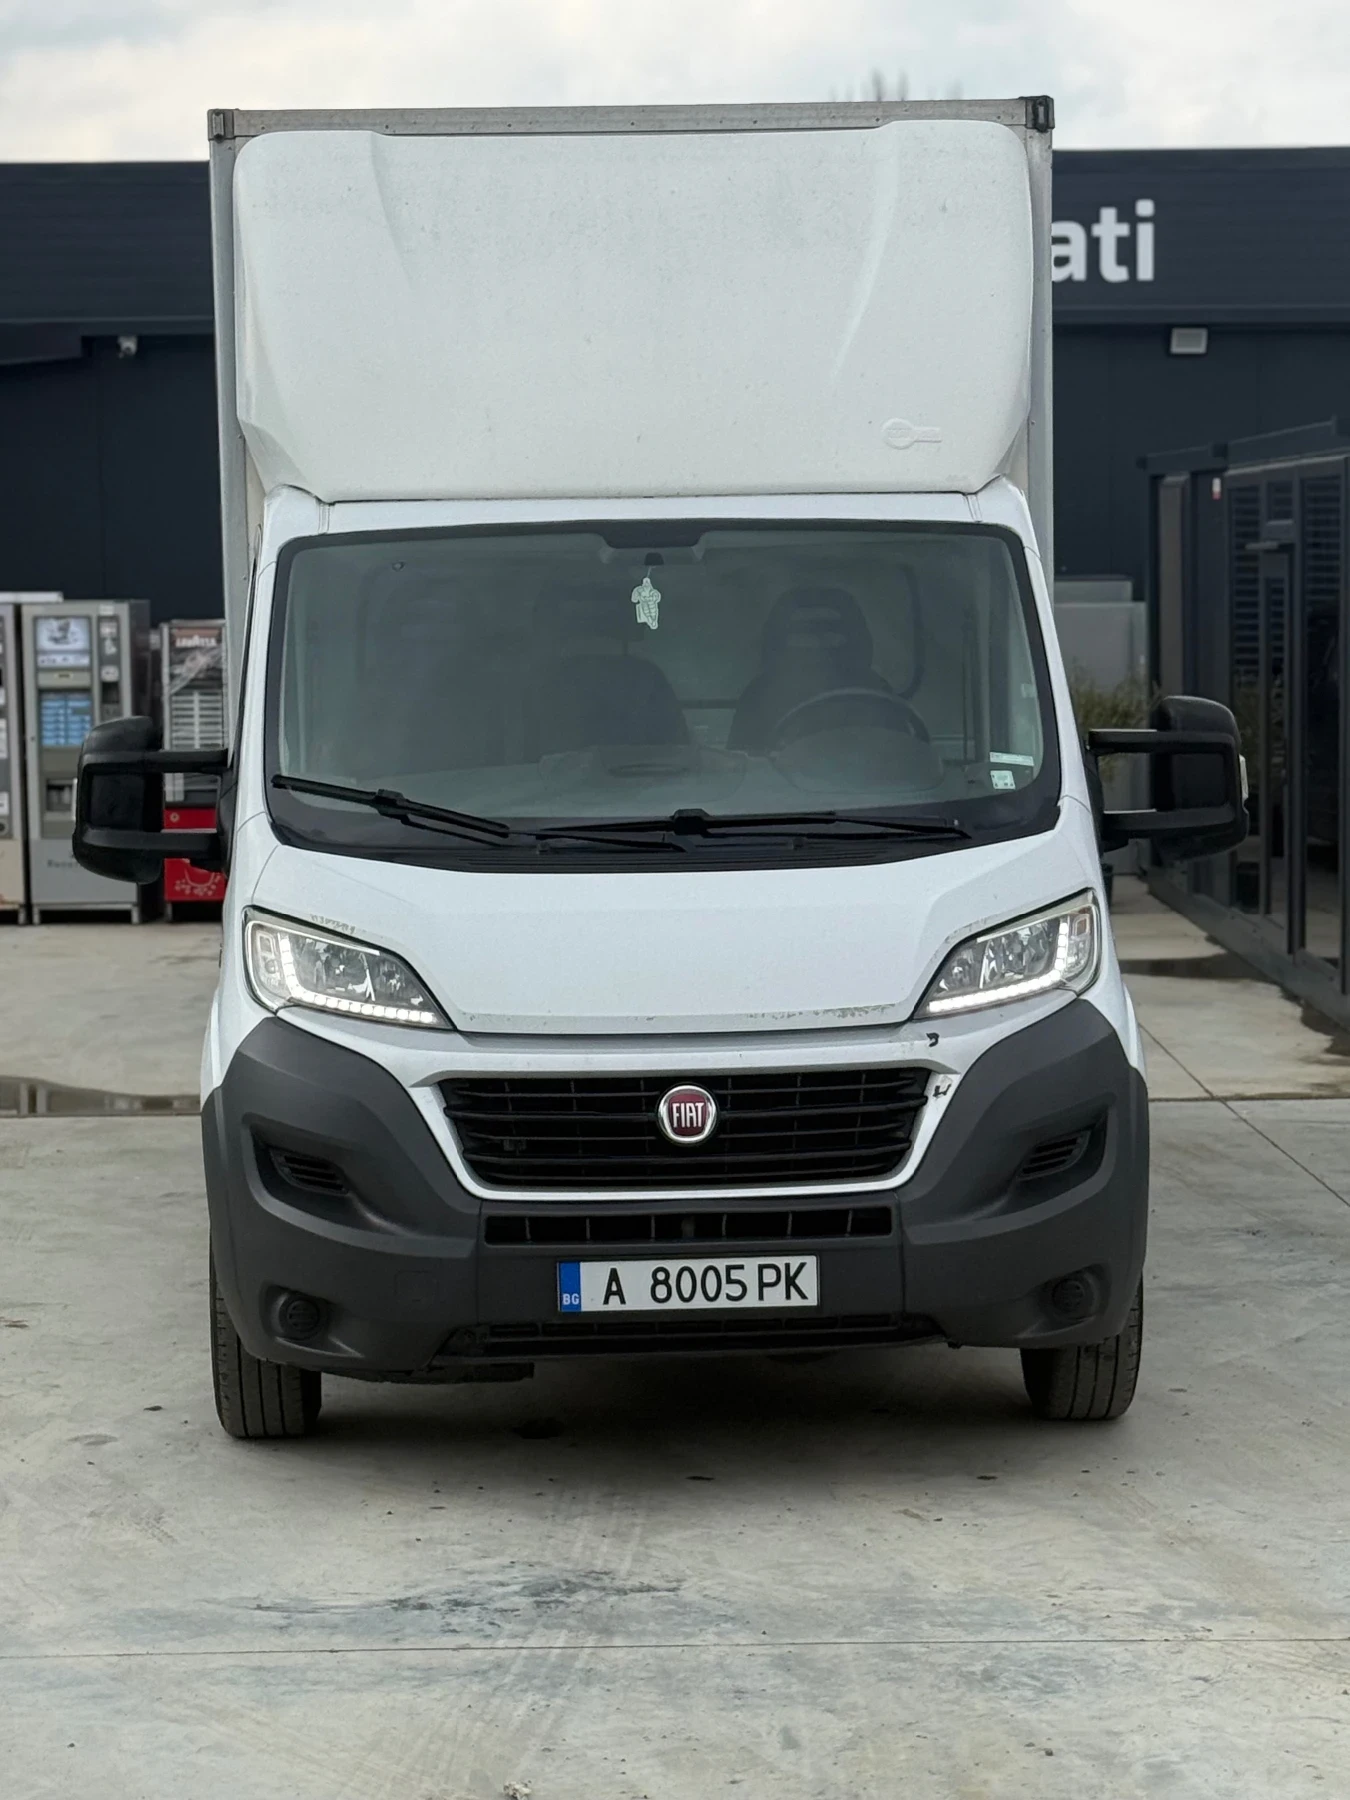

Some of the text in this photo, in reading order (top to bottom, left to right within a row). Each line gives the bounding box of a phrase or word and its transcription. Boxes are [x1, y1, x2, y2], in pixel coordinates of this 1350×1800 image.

[1051, 199, 1155, 283] ati
[672, 1102, 704, 1128] FIAT
[562, 1293, 579, 1306] BG
[602, 1267, 626, 1305] A
